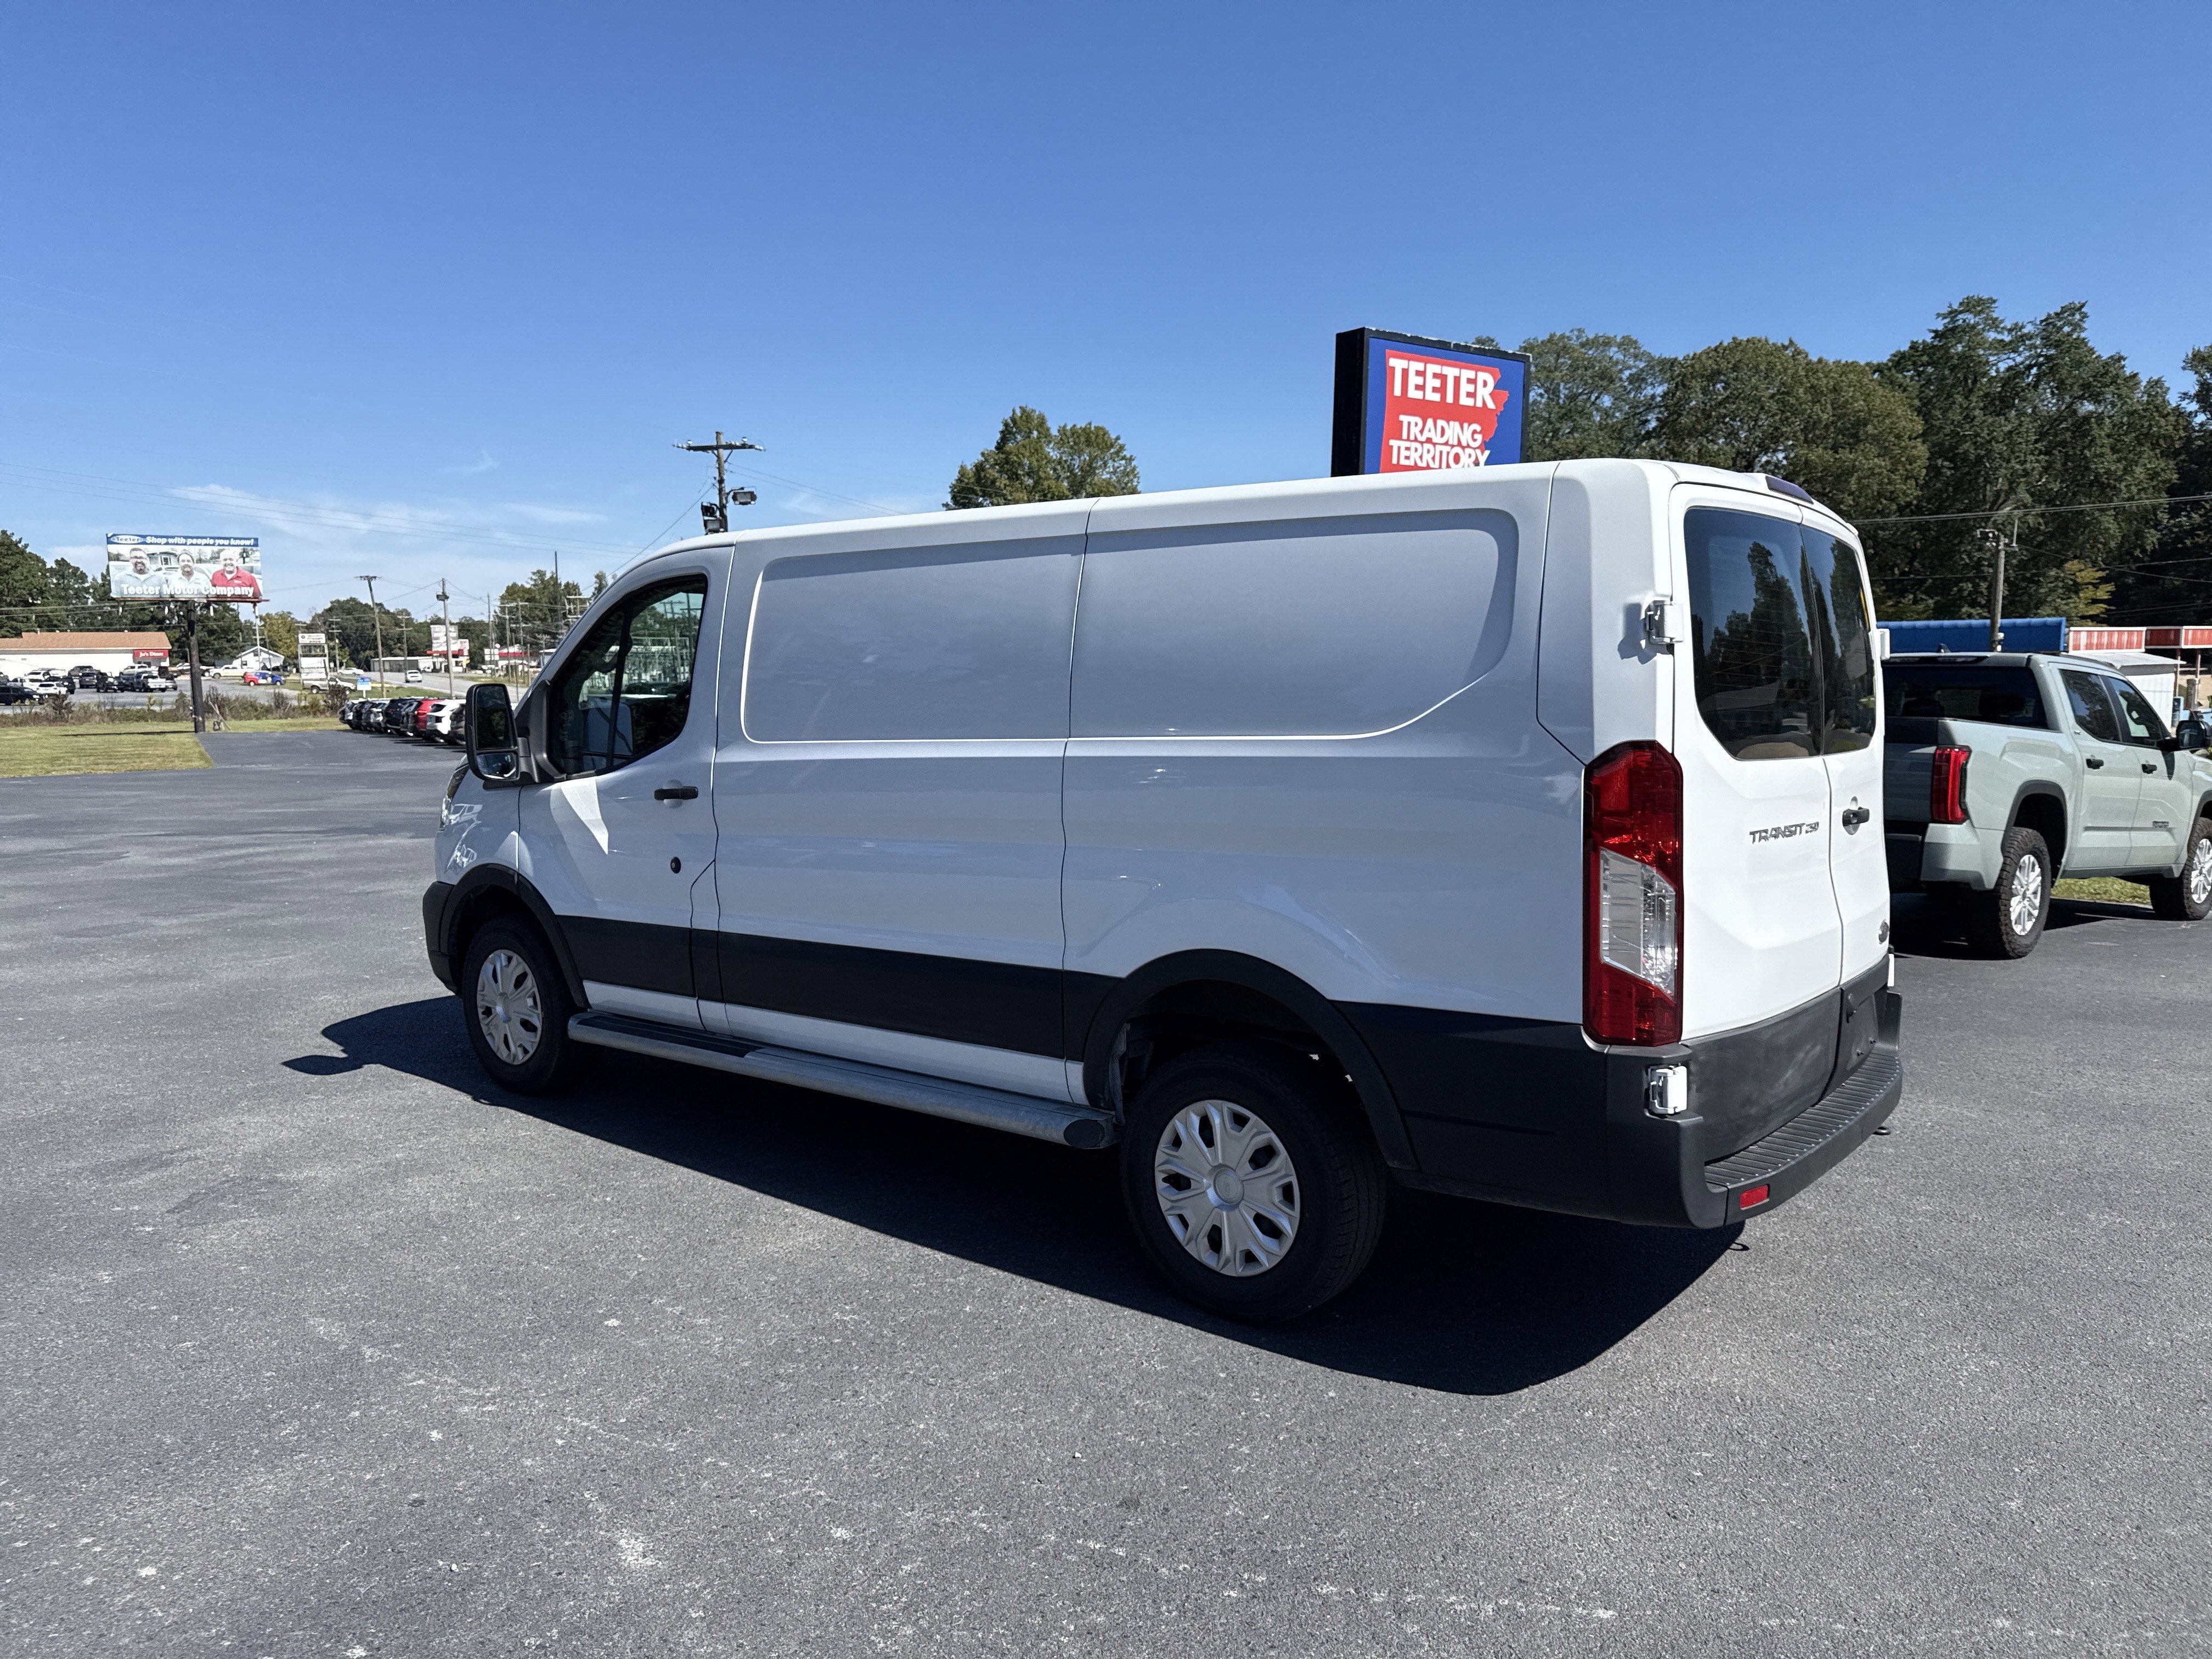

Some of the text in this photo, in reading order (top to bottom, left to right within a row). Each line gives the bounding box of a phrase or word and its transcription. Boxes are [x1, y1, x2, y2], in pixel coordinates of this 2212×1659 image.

[1388, 357, 1496, 409] TEETER
[1398, 414, 1482, 448] TRADING
[1388, 439, 1491, 469] TERRITORY
[146, 536, 167, 545] Shop
[121, 584, 254, 597] Teeter Motor Company
[1749, 822, 1805, 844] TRANSIT
